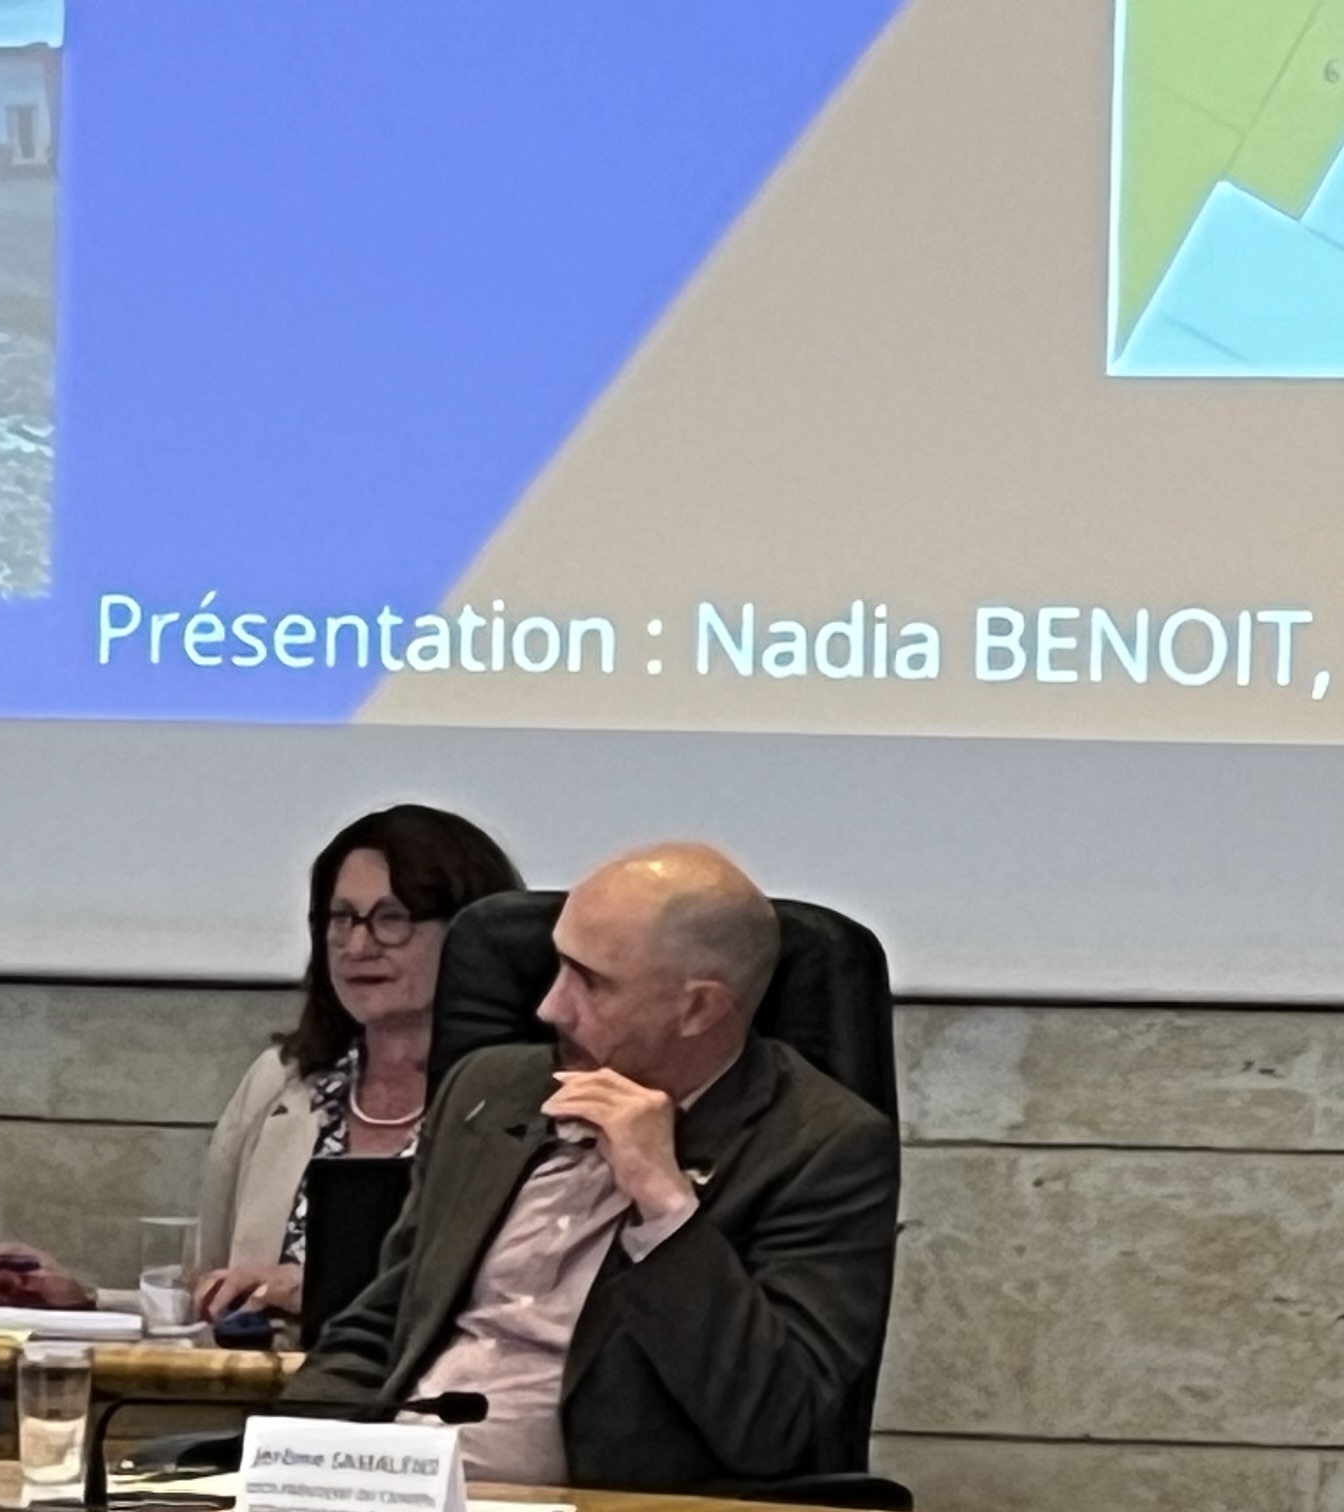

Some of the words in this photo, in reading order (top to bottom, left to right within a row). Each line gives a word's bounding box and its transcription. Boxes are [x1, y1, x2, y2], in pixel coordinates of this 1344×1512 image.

[99, 590, 616, 674] Présentation
[694, 598, 941, 680] Nadia
[974, 604, 1331, 701] BENOIT,
